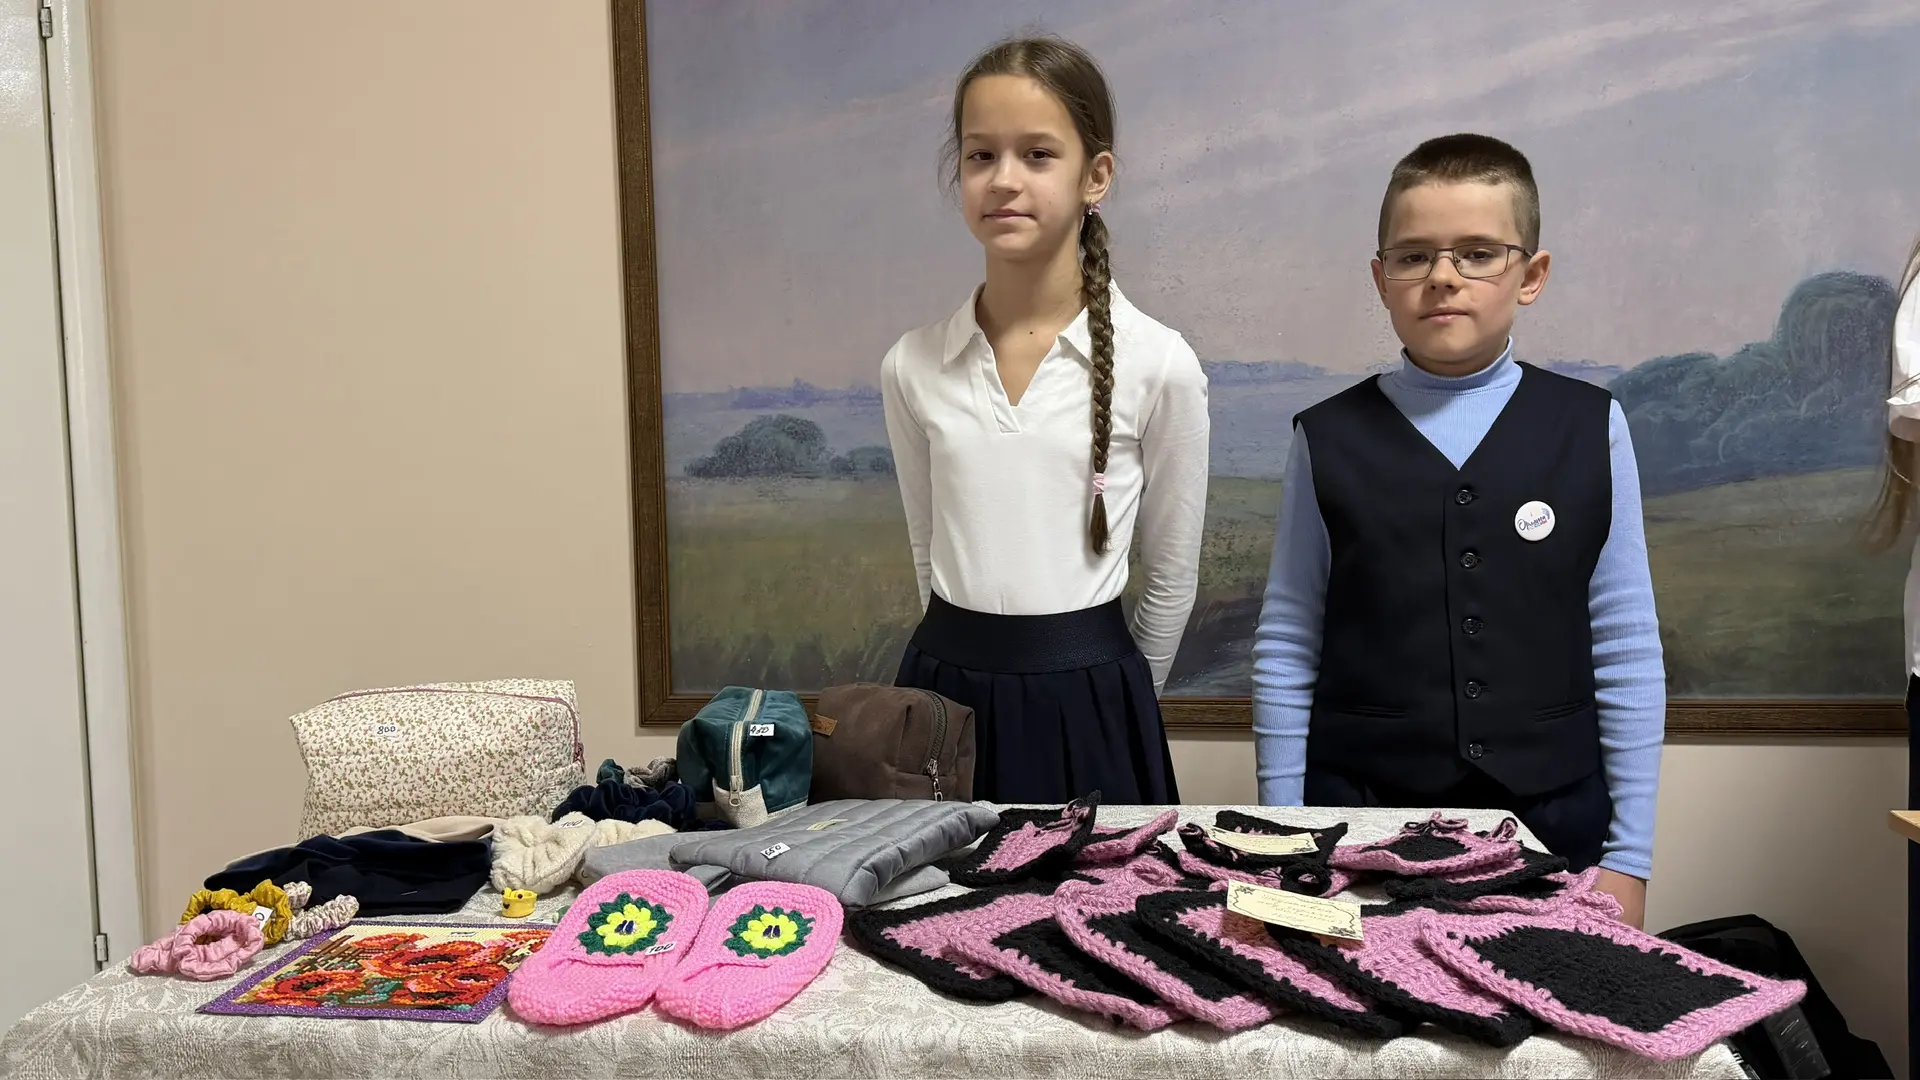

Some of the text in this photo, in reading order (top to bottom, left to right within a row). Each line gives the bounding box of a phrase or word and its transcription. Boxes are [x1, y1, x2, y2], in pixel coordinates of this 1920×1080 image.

[377, 725, 396, 735] 800
[764, 844, 782, 857] 650
[649, 943, 674, 953] 100
